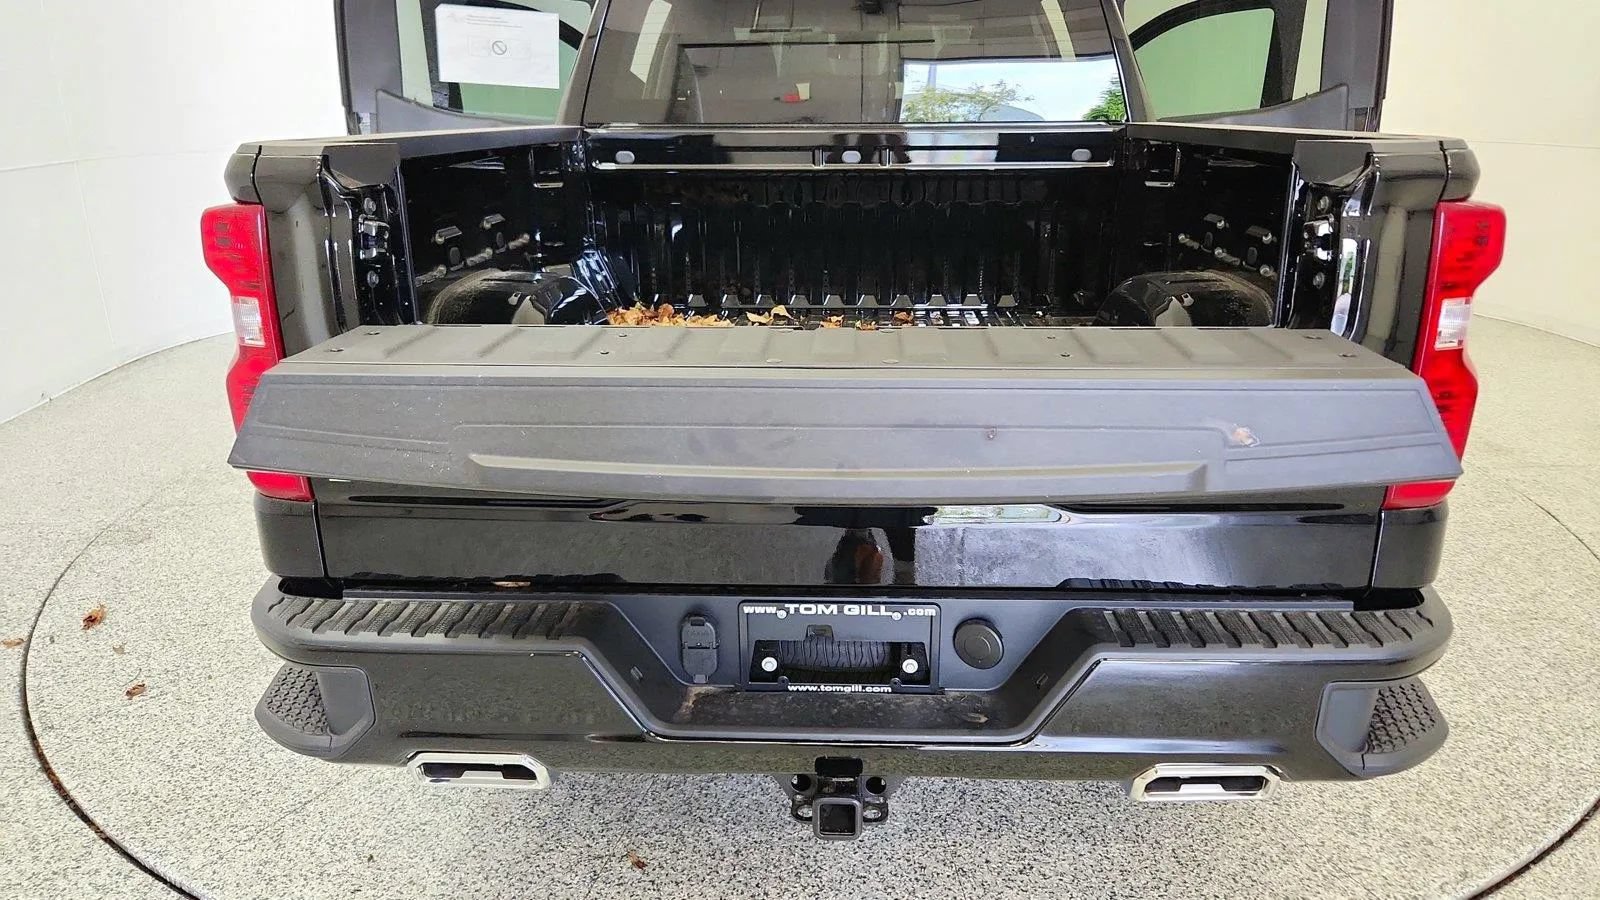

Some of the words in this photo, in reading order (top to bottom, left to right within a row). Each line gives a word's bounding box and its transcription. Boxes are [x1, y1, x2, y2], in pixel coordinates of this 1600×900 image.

[784, 603, 838, 615] TOM
[843, 604, 893, 616] GILL
[903, 608, 936, 617] .com
[787, 684, 892, 693] www.tomgill.com
